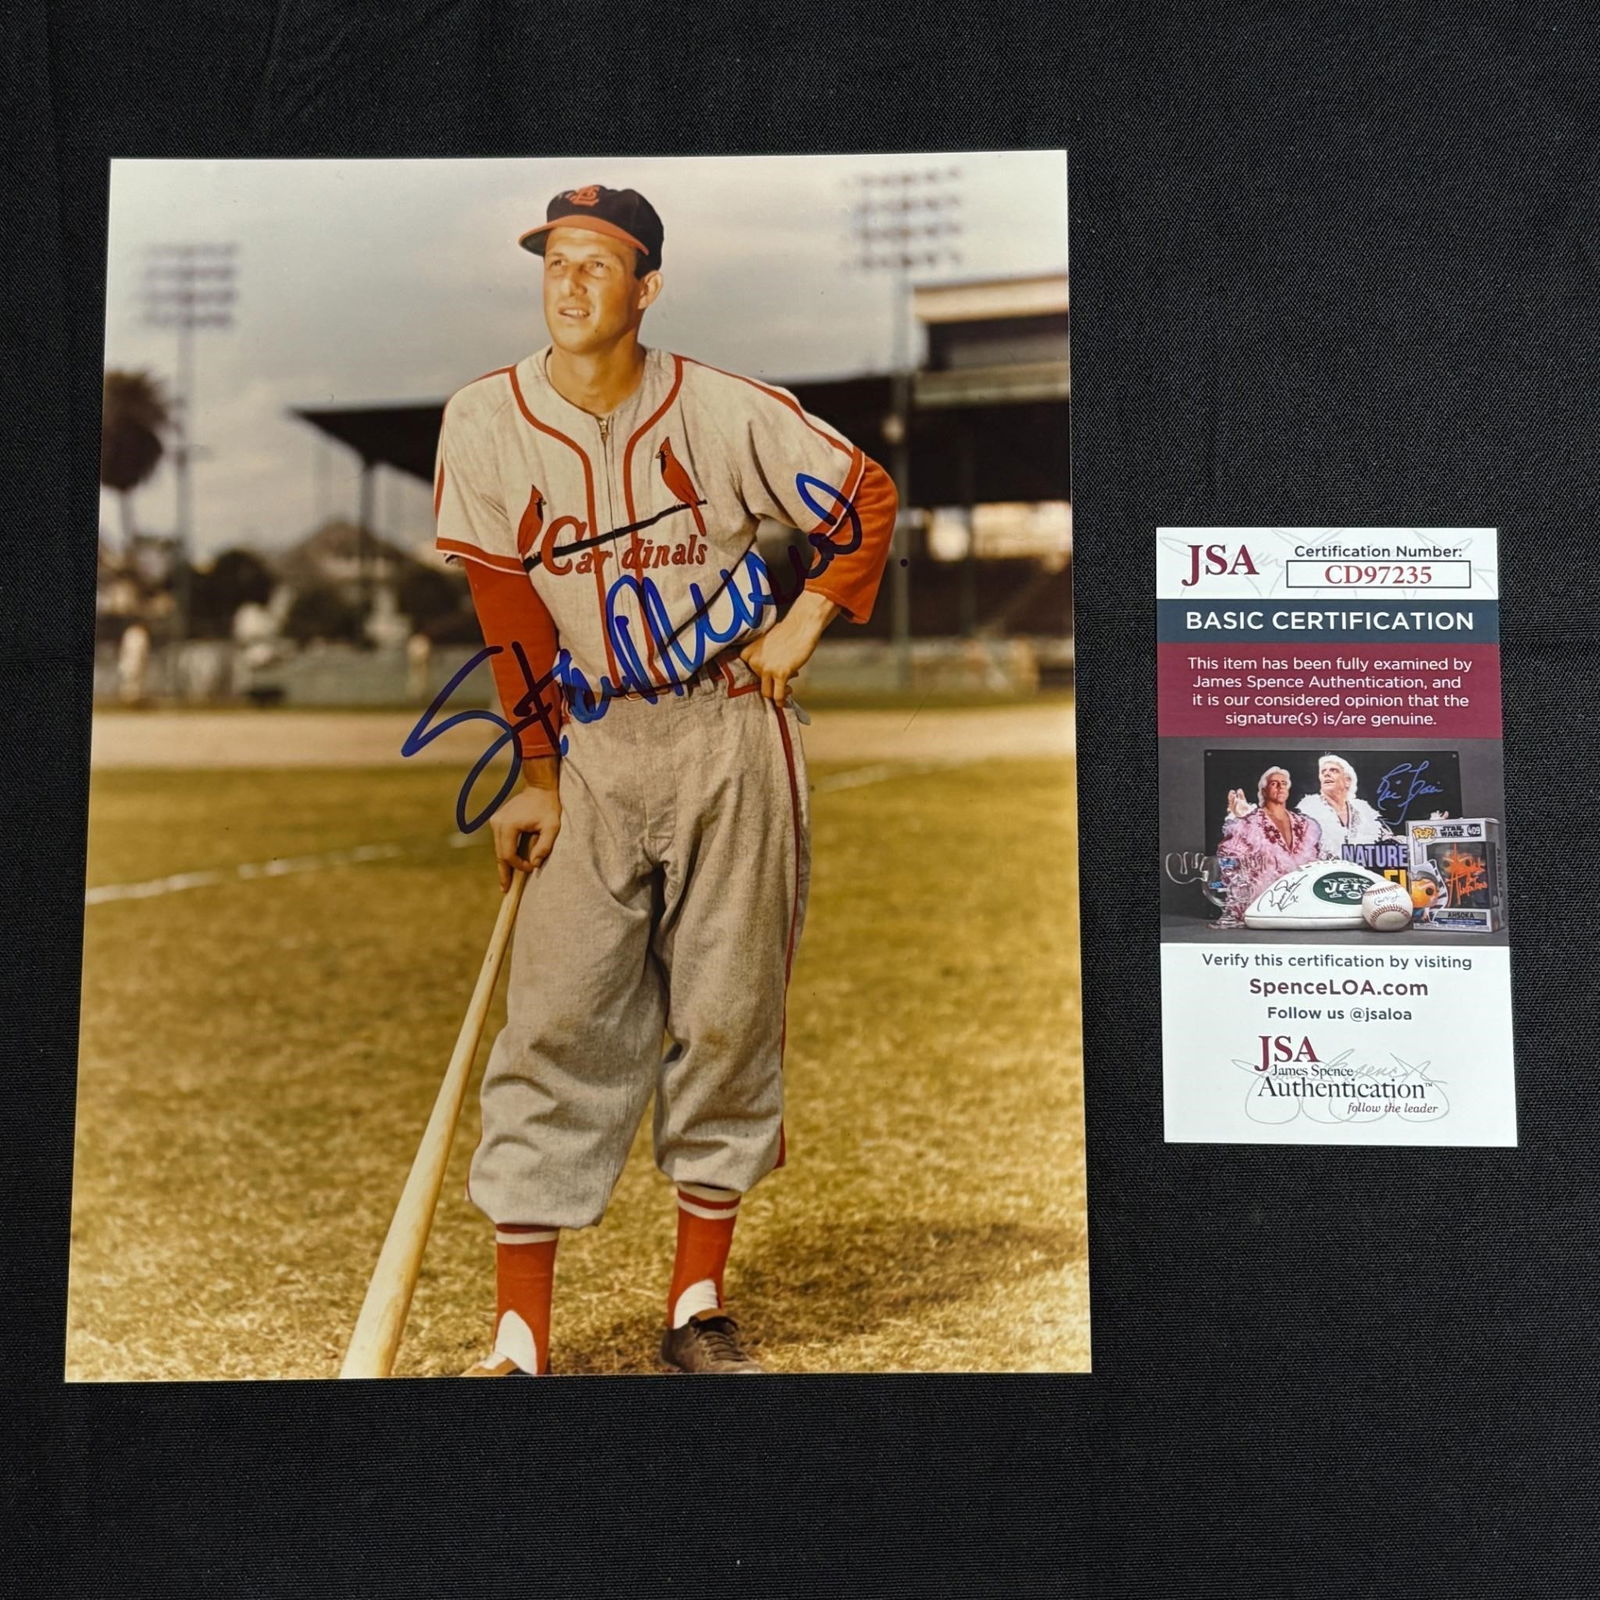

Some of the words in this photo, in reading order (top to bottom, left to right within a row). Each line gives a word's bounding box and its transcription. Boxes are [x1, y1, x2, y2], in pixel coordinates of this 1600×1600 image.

[540, 515, 709, 577] Cardinals
[1294, 545, 1391, 558] Certification
[1396, 545, 1462, 558] Number:
[1181, 544, 1260, 587] JSA
[1324, 564, 1432, 585] CD97235
[1186, 611, 1264, 630] BASIC
[1272, 611, 1474, 631] CERTIFICATION
[1187, 656, 1219, 670] This
[1223, 657, 1257, 670] item
[1262, 657, 1289, 670] has
[1293, 656, 1332, 670] been
[1336, 656, 1369, 673] fully
[1373, 657, 1449, 671] examined
[1453, 657, 1473, 673] by
[1192, 675, 1242, 688] James
[1246, 675, 1304, 690] Spence
[1308, 675, 1428, 690] Authentication,
[1432, 675, 1461, 689] and
[1192, 693, 1203, 706] it
[1207, 693, 1220, 706] is
[1223, 696, 1251, 706] our
[1254, 693, 1340, 707] considered
[1344, 693, 1403, 709] opinion
[1407, 693, 1440, 707] that
[1443, 693, 1470, 707] the
[1225, 711, 1319, 727] signature(s)
[1323, 710, 1367, 727] is/are
[1370, 712, 1437, 728] genuine.
[1341, 843, 1408, 867] NATURE
[1201, 953, 1250, 969] Verify
[1254, 953, 1283, 967] this
[1288, 954, 1385, 968] certification
[1389, 955, 1409, 970] by
[1414, 955, 1472, 971] visiting
[1249, 978, 1429, 998] SpenceLOA.com
[1267, 1006, 1322, 1020] Follow
[1327, 1009, 1345, 1020] us
[1350, 1007, 1412, 1023] @jsaloa
[1253, 1034, 1321, 1072] JSA
[1271, 1064, 1309, 1077] James
[1311, 1064, 1354, 1078] Spence
[1347, 1102, 1381, 1115] follow
[1384, 1103, 1401, 1114] the
[1404, 1104, 1439, 1114] leader
